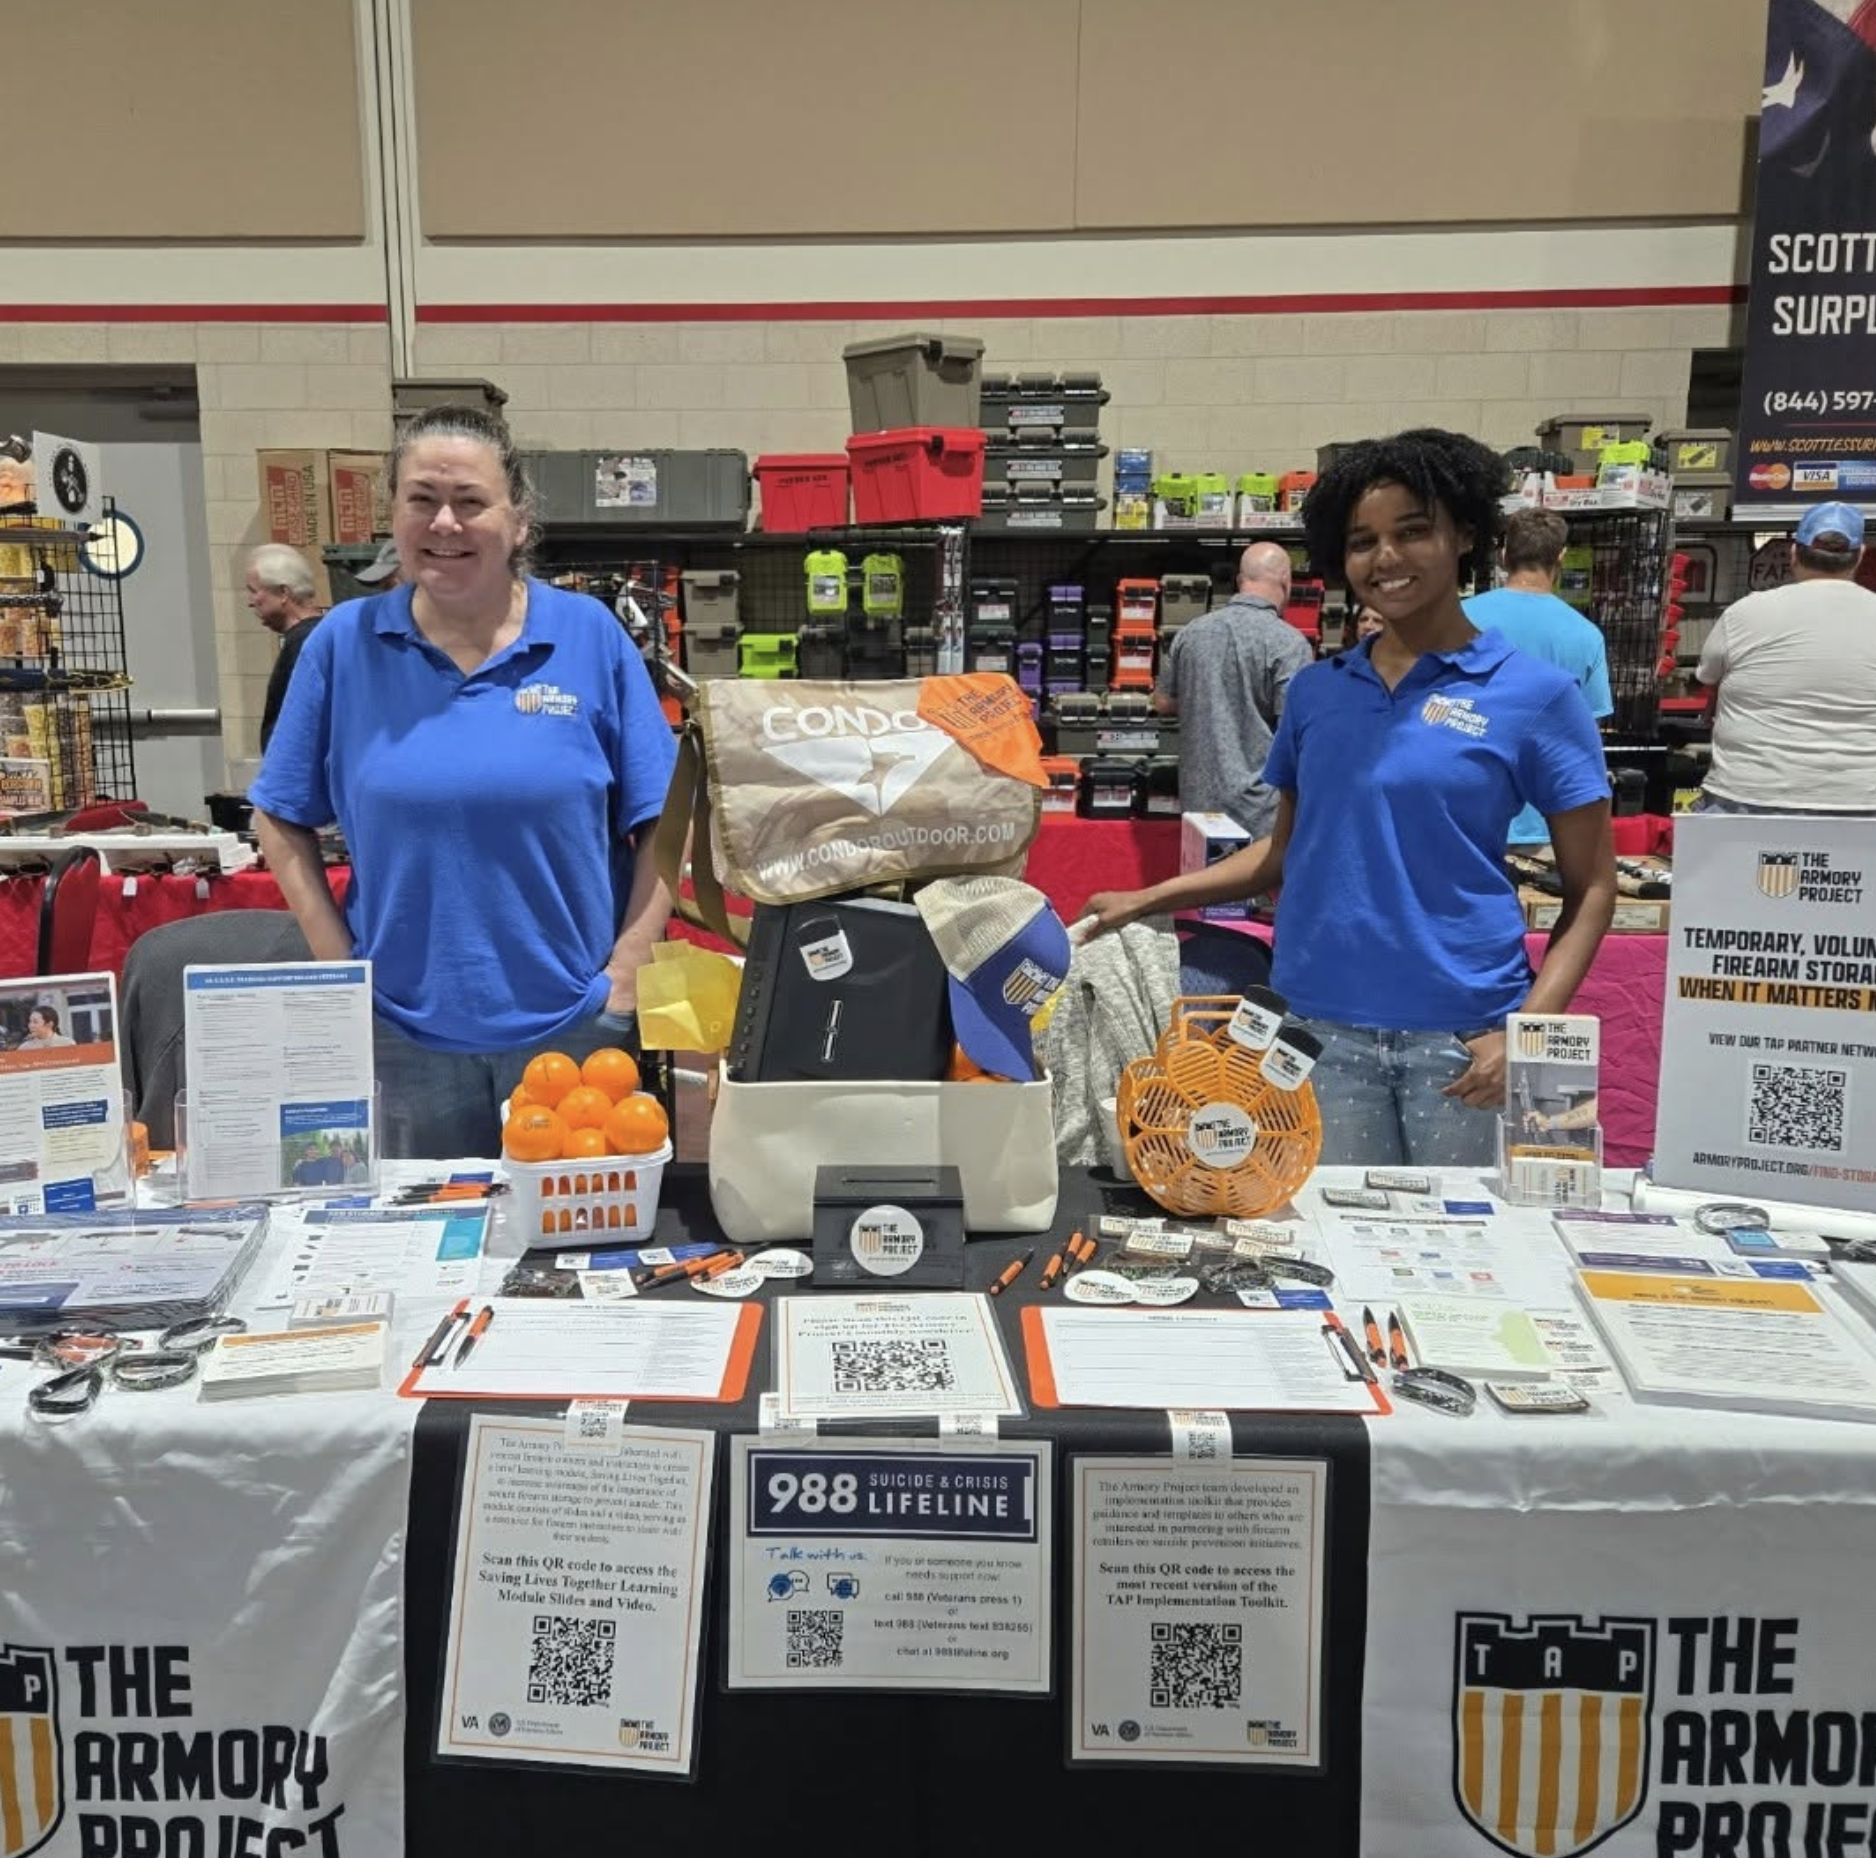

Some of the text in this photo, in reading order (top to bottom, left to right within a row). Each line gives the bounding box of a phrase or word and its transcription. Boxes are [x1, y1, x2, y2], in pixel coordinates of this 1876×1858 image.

[1763, 390, 1828, 416] (844)
[1803, 471, 1831, 481] VISA
[302, 465, 319, 545] MADE IN USA
[957, 689, 984, 707] THE
[969, 683, 1014, 716] ARMORY
[763, 705, 932, 741] CONDO
[1449, 707, 1489, 728] ARMORY
[1444, 717, 1487, 737] PROJECT
[757, 822, 1015, 881] WWW.CONDOROUTDOOR.COM
[1802, 852, 1829, 869] THE
[1800, 870, 1863, 889] ARMORY
[1799, 887, 1863, 904] PROJECT
[1684, 927, 1806, 957] TEMPORARY,
[1712, 954, 1799, 980] FIREARM
[1679, 976, 1861, 1011] WHEN IT MATTERS
[1547, 1022, 1567, 1034] THE
[1547, 1035, 1590, 1048] ARMORY
[1709, 1033, 1876, 1058] VIEW OUR TAP PARTNER NETW
[1546, 1048, 1591, 1061] PROJECT
[883, 1223, 898, 1234] THE
[883, 1244, 918, 1255] PROJECT
[869, 1473, 1008, 1490] SUICIDE & CRISIS
[1099, 1482, 1118, 1492] The
[1121, 1482, 1159, 1494] Armory
[1163, 1482, 1200, 1494] Project
[1202, 1483, 1228, 1493] team
[1231, 1482, 1283, 1495] developed
[768, 1473, 858, 1513] 988
[869, 1493, 1008, 1517] LIFELINE
[1246, 1497, 1292, 1508] provides
[1093, 1509, 1139, 1520] guidance
[1144, 1509, 1159, 1519] and
[1227, 1511, 1260, 1521] others
[1263, 1512, 1284, 1521] who
[1227, 1525, 1249, 1534] with
[766, 1547, 802, 1560] Talk
[806, 1547, 846, 1561] with
[483, 1553, 677, 1578] Scan this QR code to access the
[894, 1557, 912, 1567] you
[927, 1558, 972, 1568] someone
[976, 1559, 993, 1569] you
[996, 1559, 1022, 1568] know
[1100, 1563, 1296, 1577] Scan this QR code to access the
[479, 1570, 678, 1598] Saving Lives Together Learning
[906, 1570, 974, 1582] needs support
[1117, 1580, 1278, 1592] most recent version of the
[498, 1589, 657, 1612] Module Slides and Video.
[927, 1593, 976, 1604] (Veterans
[980, 1596, 1008, 1605] press
[1012, 1595, 1022, 1606] 1)
[1106, 1595, 1288, 1609] TAP Implementation Toolkit.
[874, 1619, 893, 1628] text
[918, 1620, 966, 1631] (Veterans
[970, 1621, 989, 1630] text
[897, 1647, 920, 1656] chat
[1668, 1616, 1799, 1695] THE
[24, 1675, 42, 1702] P
[65, 1646, 193, 1717] THE
[461, 1715, 480, 1729] VA
[1092, 1724, 1110, 1736] VA
[75, 1725, 329, 1810] ARMORY
[1657, 1800, 1876, 1858] PROJE
